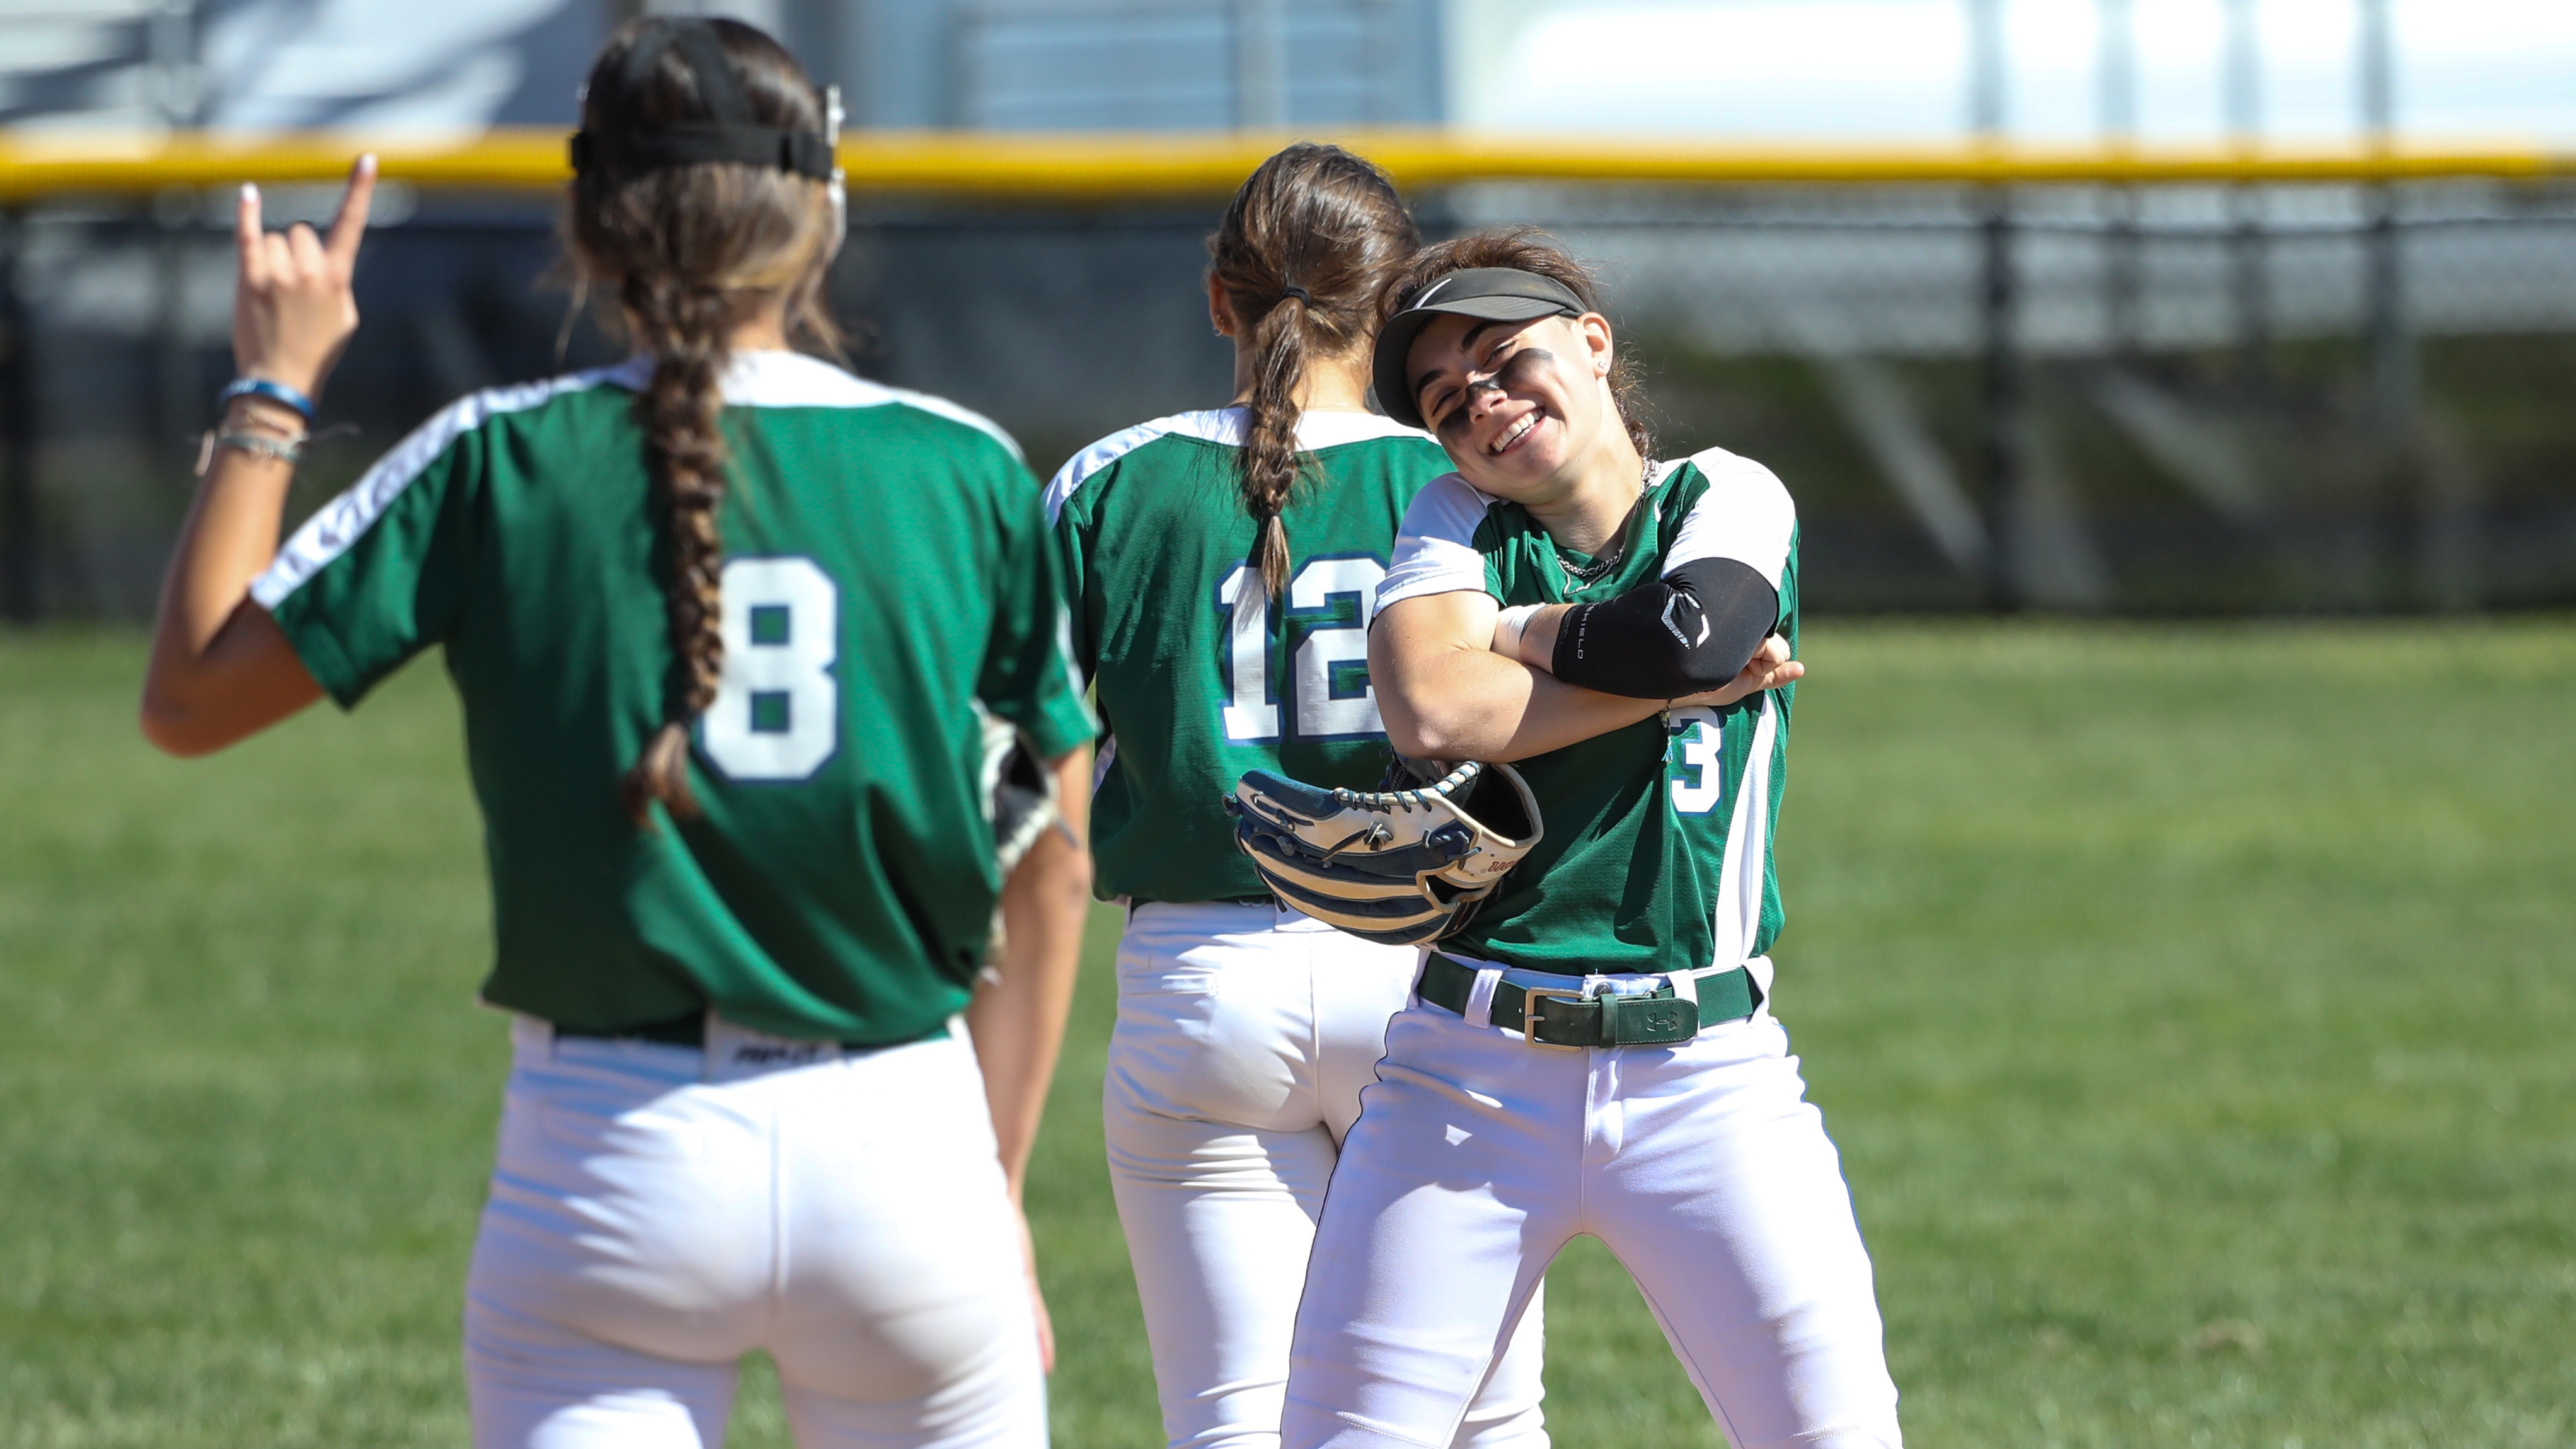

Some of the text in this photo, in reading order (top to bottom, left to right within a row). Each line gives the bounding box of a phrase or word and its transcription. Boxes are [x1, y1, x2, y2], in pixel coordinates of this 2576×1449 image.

[704, 557, 837, 780] 8
[1221, 558, 1386, 739] 12
[1669, 705, 1722, 812] 3
